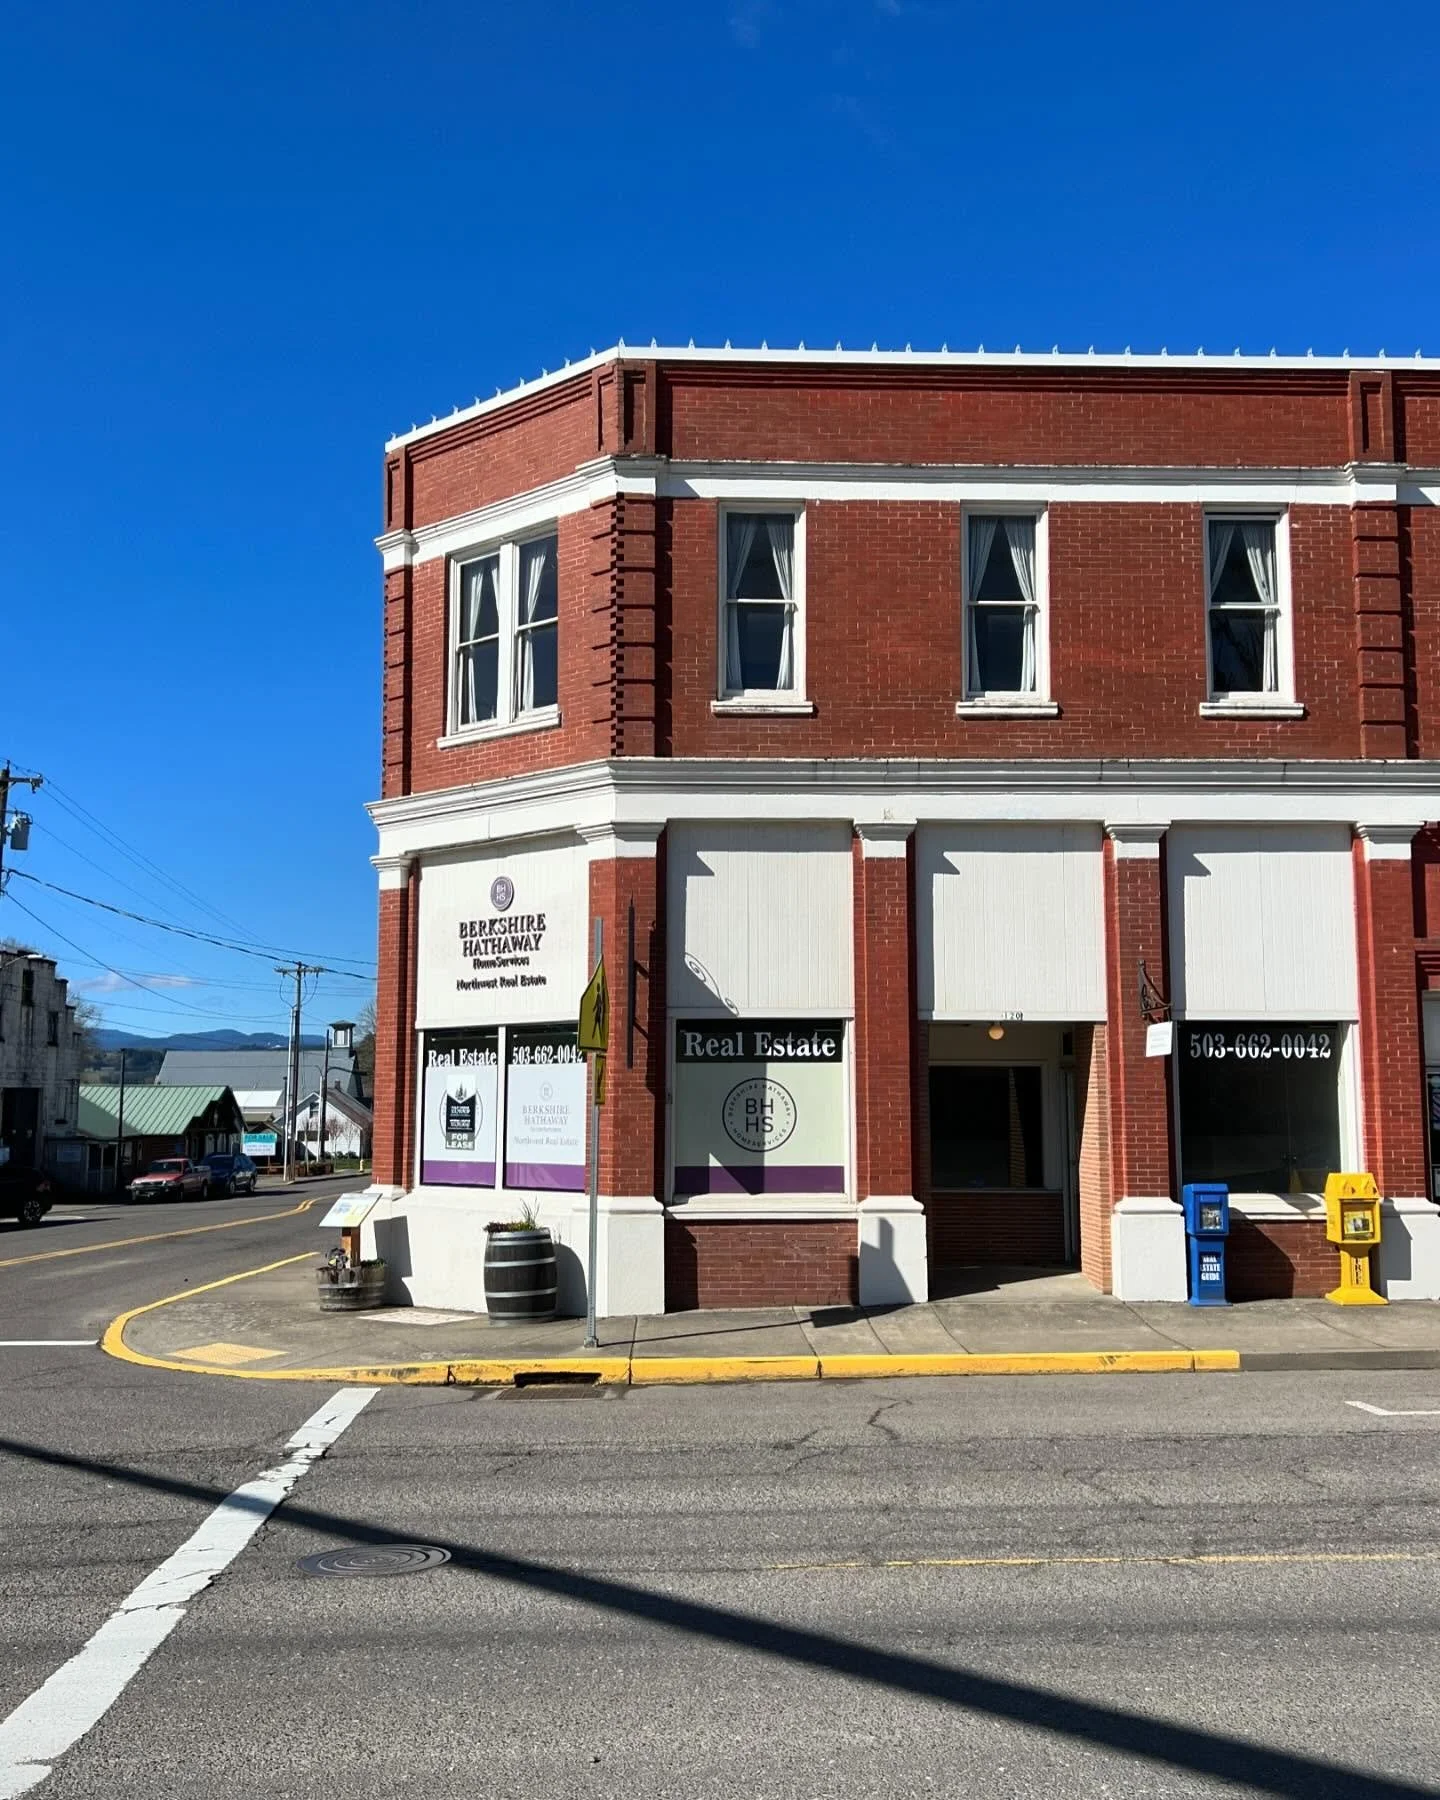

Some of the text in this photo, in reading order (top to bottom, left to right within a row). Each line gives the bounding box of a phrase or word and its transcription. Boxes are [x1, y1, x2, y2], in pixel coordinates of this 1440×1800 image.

[459, 913, 546, 938] BERKSHIRE
[462, 933, 543, 957] HATHAWAY
[473, 956, 530, 970] HomeServices
[456, 974, 547, 991] Northwest Real Estate
[684, 1031, 836, 1056] Real Estate
[1190, 1033, 1331, 1059] 503-662-0042
[428, 1048, 497, 1067] Real Estate
[522, 1104, 571, 1114] BERKSHIRE
[745, 1098, 774, 1115] BH
[524, 1115, 568, 1125] HATHAWAY
[745, 1116, 774, 1133] HS
[447, 1140, 474, 1149] LEASE
[451, 1133, 468, 1141] FOR
[1201, 1272, 1220, 1281] GUIDE
